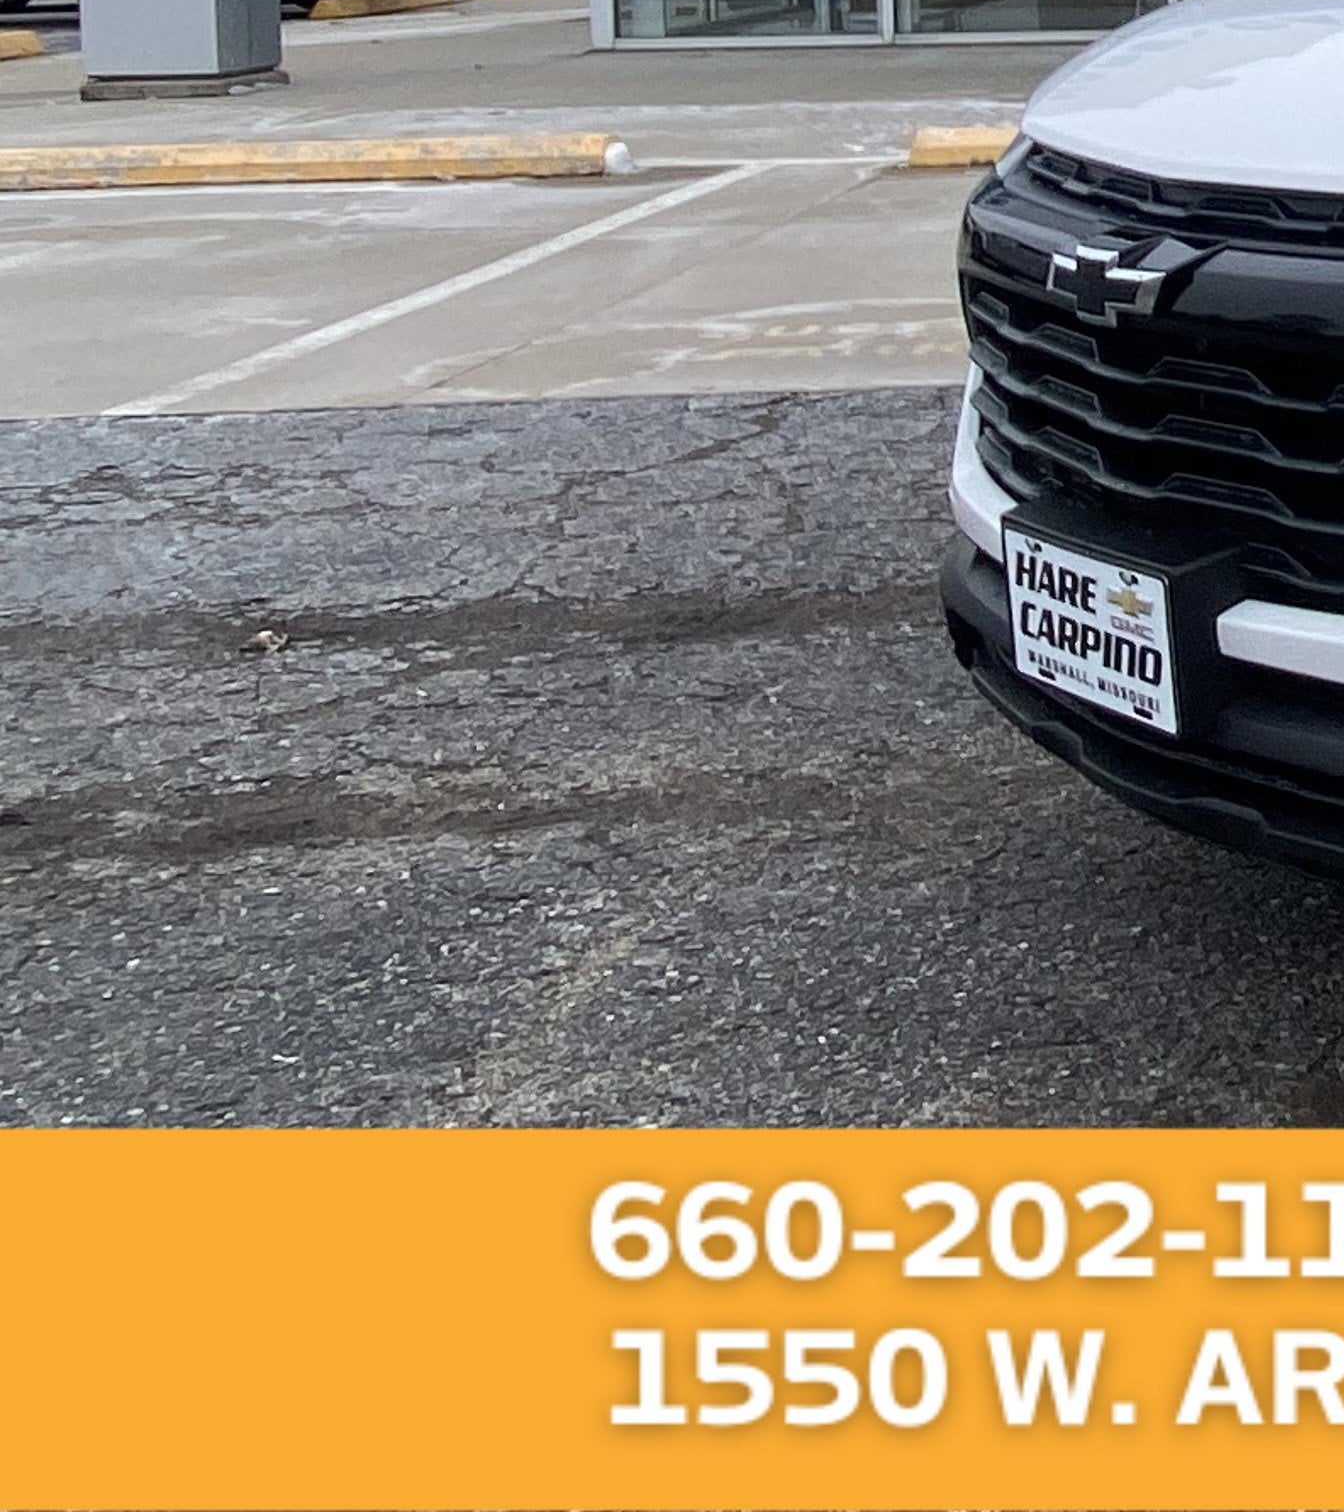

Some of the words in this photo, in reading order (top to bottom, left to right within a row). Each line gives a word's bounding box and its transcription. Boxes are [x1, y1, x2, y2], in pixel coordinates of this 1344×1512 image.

[1014, 550, 1098, 616] HARE
[1020, 600, 1163, 687] CARPINO
[1097, 677, 1162, 714] MISSOURI
